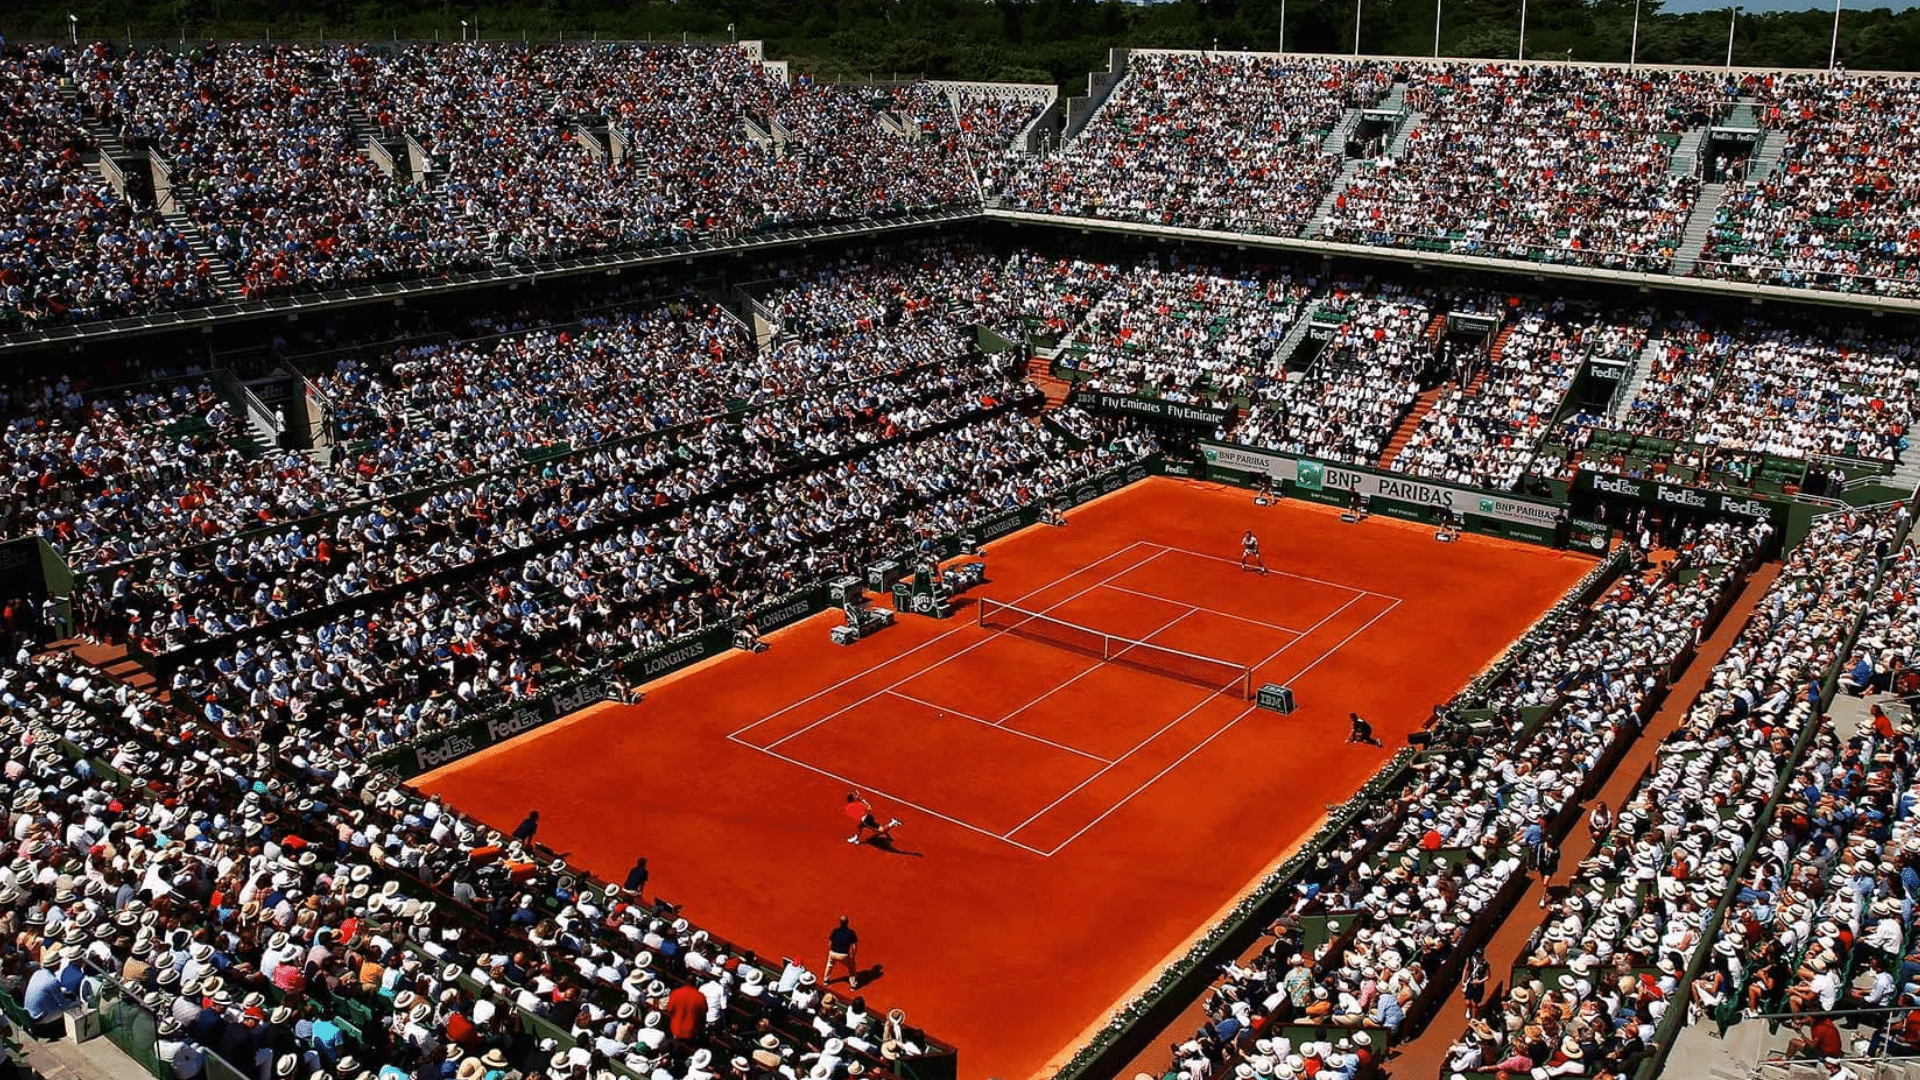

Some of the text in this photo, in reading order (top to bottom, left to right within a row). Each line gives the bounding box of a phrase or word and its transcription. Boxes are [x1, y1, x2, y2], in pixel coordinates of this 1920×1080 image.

[1102, 396, 1161, 413] Fly Emirates
[1167, 405, 1183, 419] Fly
[1326, 469, 1454, 506] BNP PARIBAS
[1593, 475, 1772, 518] FedEx FedEx FedEx
[1495, 501, 1516, 512] BNP
[1516, 506, 1558, 520] PARIBAS
[757, 600, 810, 630] LONGINES
[643, 642, 705, 676] LONGINES
[551, 683, 602, 715] FedEx
[1260, 692, 1282, 708] IBM
[487, 707, 543, 741] FedEx
[415, 734, 475, 770] FedEx
